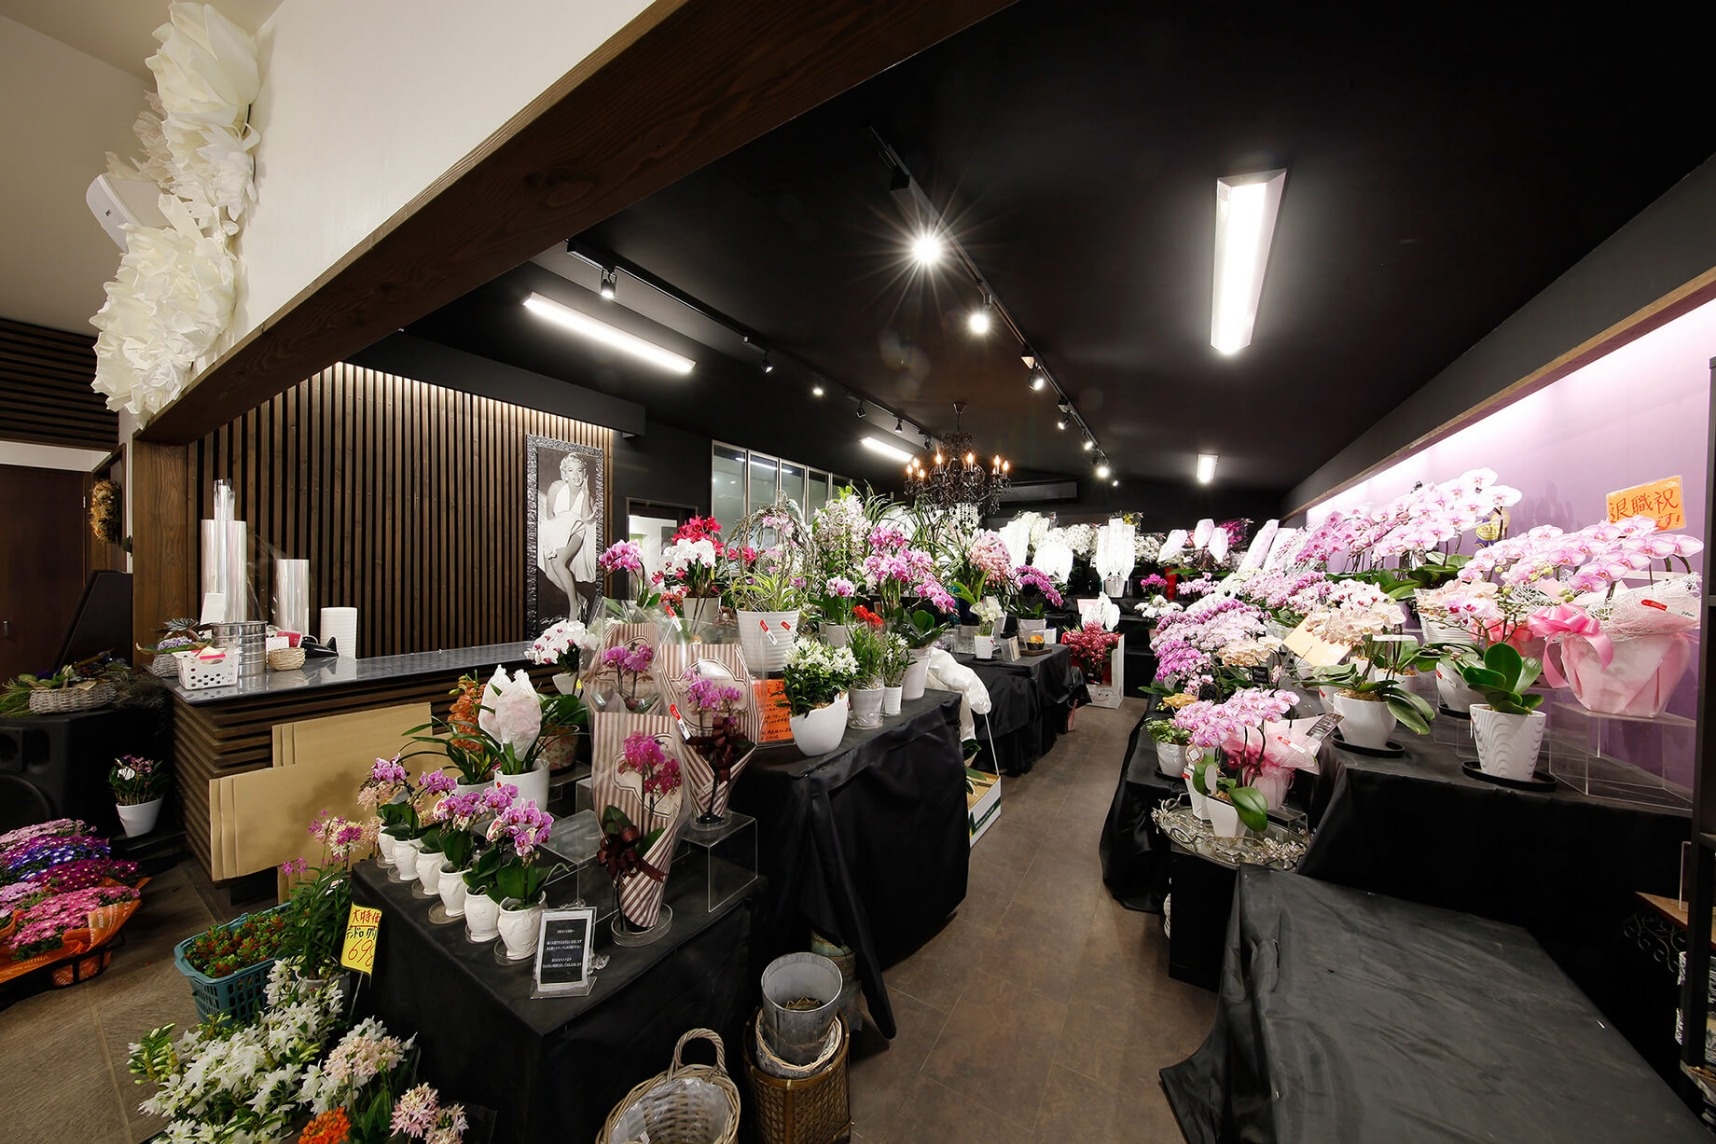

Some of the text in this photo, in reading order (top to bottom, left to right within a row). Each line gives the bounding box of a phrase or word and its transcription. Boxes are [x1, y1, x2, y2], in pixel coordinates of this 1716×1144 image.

[1609, 488, 1678, 523] 退職祝
[351, 908, 380, 924] 大特価
